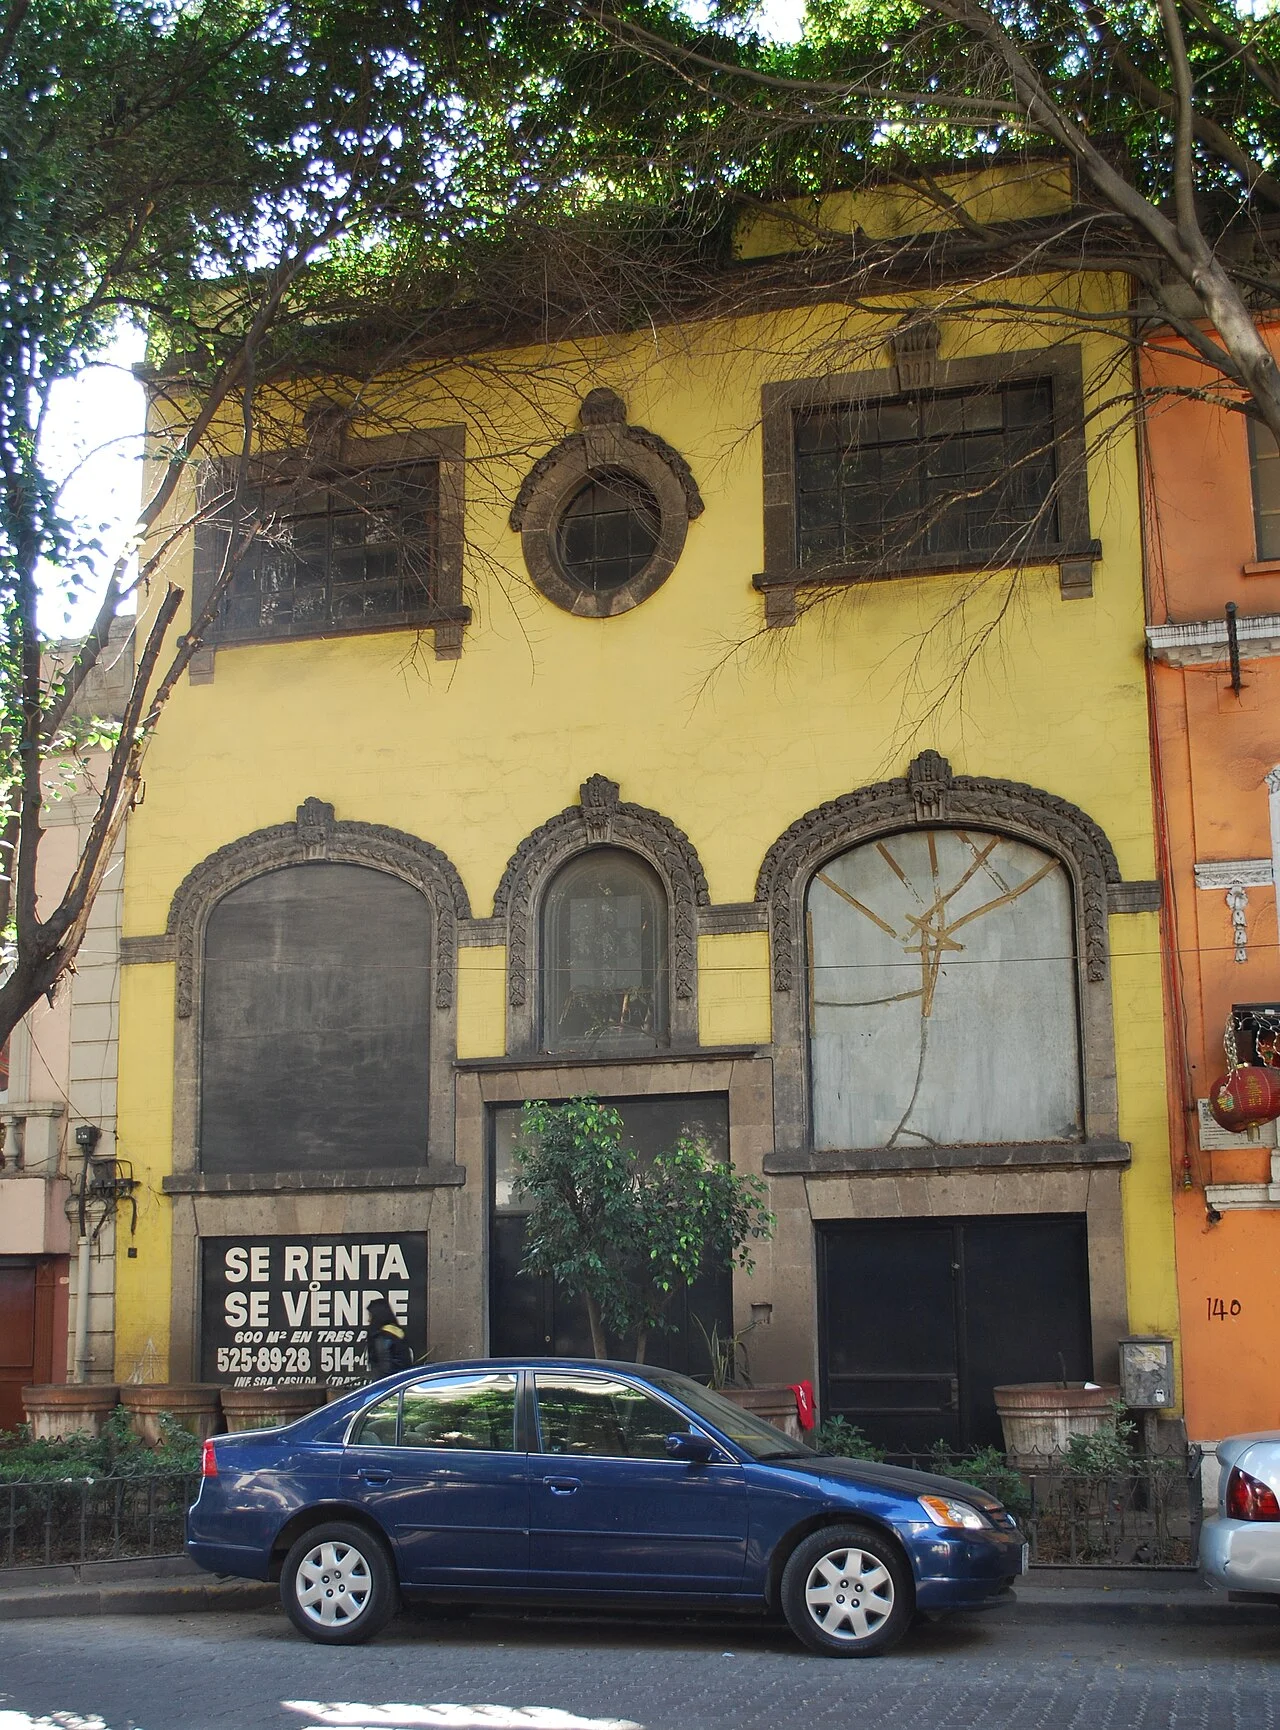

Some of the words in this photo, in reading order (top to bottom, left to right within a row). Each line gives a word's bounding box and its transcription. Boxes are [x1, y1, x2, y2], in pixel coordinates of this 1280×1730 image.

[225, 1247, 270, 1283] SE
[284, 1244, 410, 1281] RENTA
[225, 1291, 269, 1328] SE
[1206, 1297, 1242, 1321] 140
[234, 1331, 263, 1343] 600
[290, 1331, 313, 1343] EN
[317, 1330, 355, 1343] TRES
